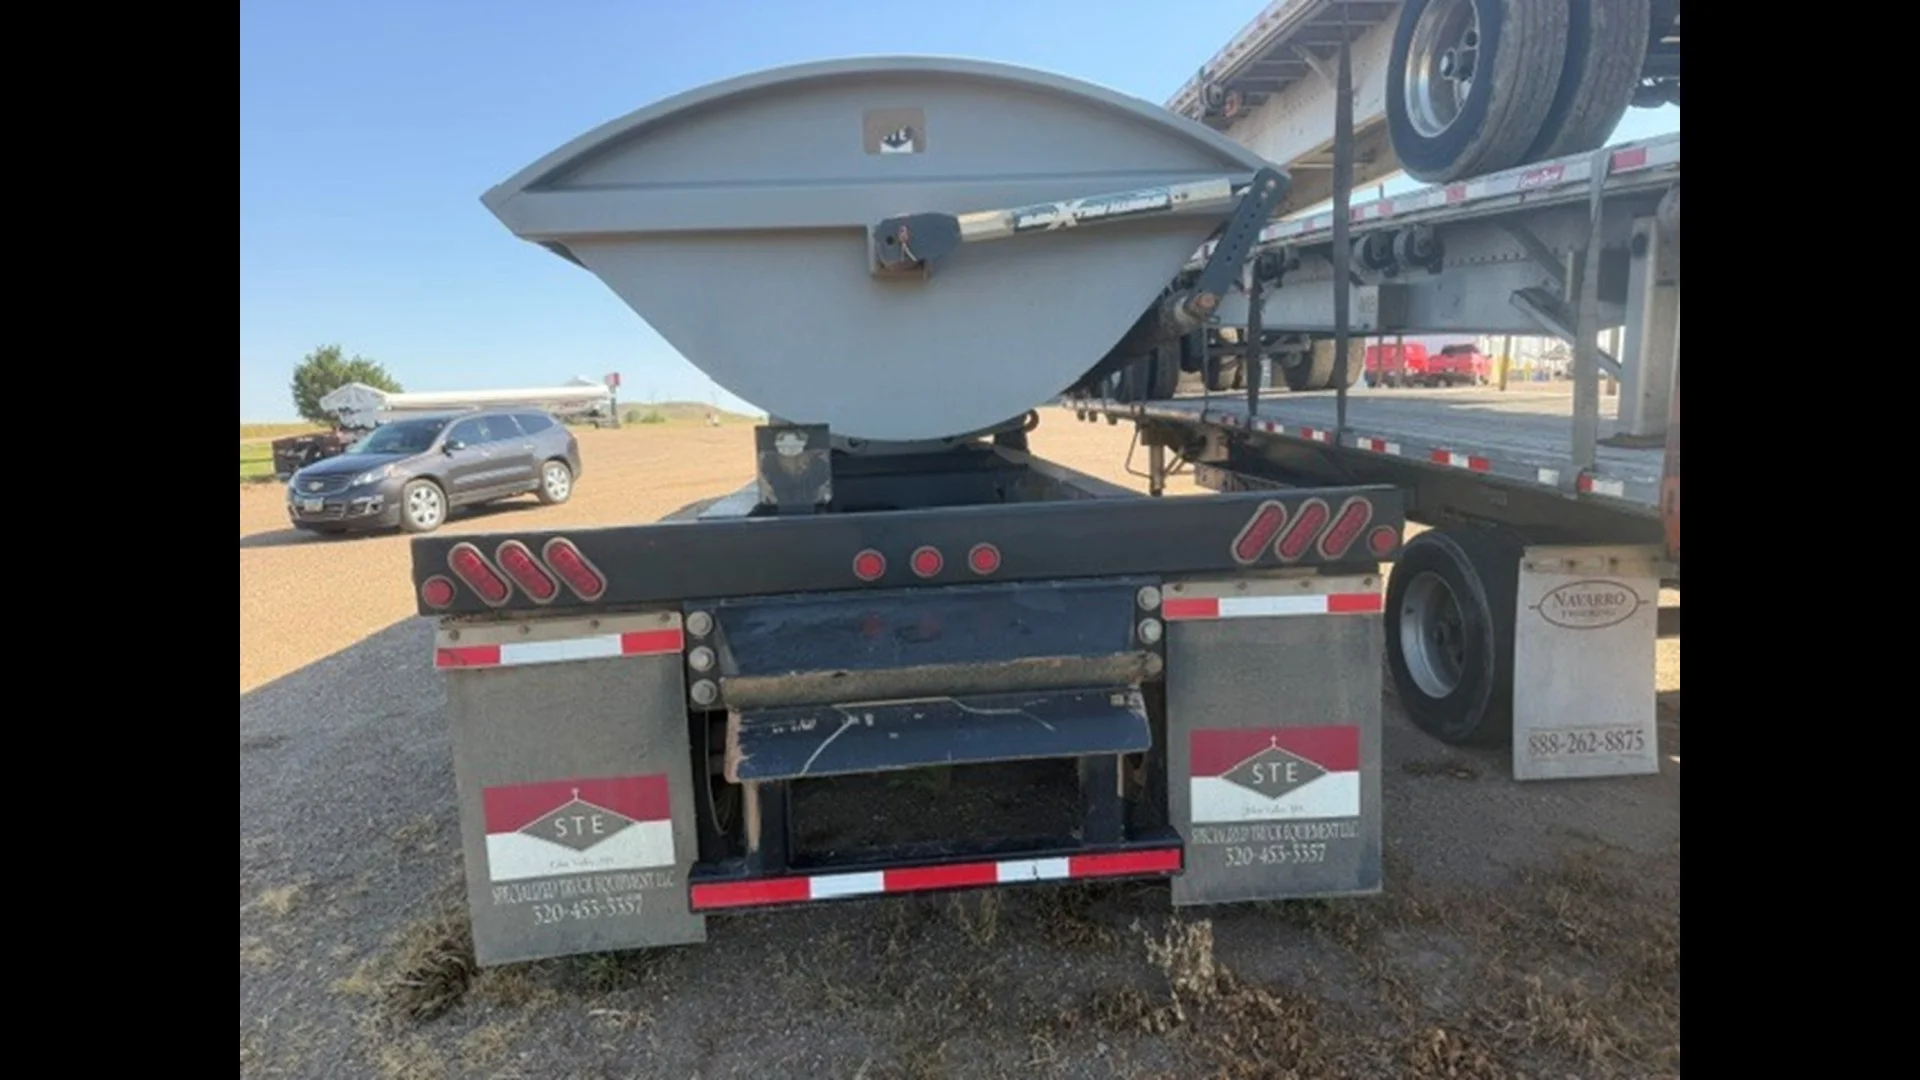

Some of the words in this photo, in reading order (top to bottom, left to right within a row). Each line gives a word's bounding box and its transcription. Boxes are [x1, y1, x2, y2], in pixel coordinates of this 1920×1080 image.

[1552, 591, 1626, 609] NAVARRO
[1528, 729, 1645, 756] 888-262-8875
[1252, 762, 1299, 784] STE
[554, 814, 605, 837] STE
